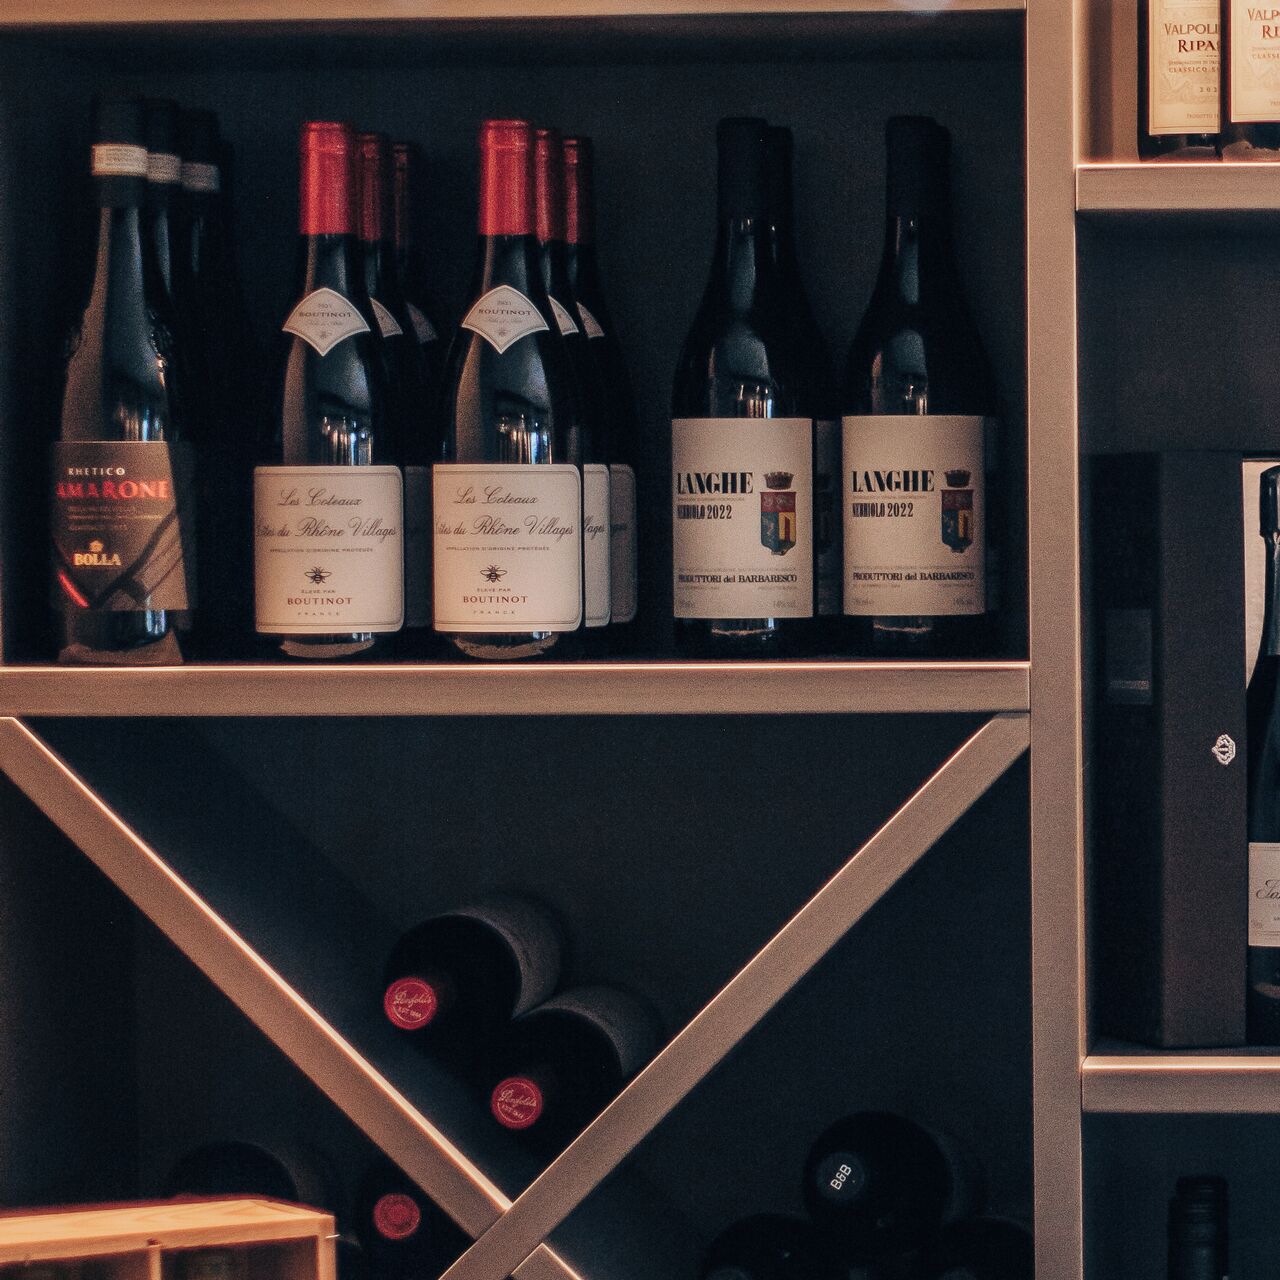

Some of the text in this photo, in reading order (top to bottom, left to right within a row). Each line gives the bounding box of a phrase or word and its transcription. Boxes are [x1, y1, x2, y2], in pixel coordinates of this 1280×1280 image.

[1178, 39, 1220, 53] RIPA
[478, 308, 531, 316] BOUTINOT
[68, 467, 125, 476] RHETICO
[56, 480, 169, 499] AMARONE
[677, 472, 754, 495] LANGHE
[852, 470, 934, 493] LANGHE
[278, 487, 362, 506] Les Coteaux
[453, 486, 538, 505] Les Coteaux
[707, 504, 732, 519] 2022
[887, 502, 914, 517] 2022
[277, 517, 397, 544] du Rhône Villages
[453, 515, 573, 544] du Rhône Villages
[73, 553, 121, 566] BOLLA
[723, 574, 735, 583] del
[738, 574, 797, 583] BARBARESCO
[852, 572, 975, 580] PRODUTTORI del BARBARESCO
[287, 597, 352, 605] BOUTINOT
[462, 596, 528, 604] BOUTINOT
[394, 991, 431, 1008] Penfolds
[499, 1089, 537, 1107] Penfolds
[830, 1163, 852, 1191] B&B
